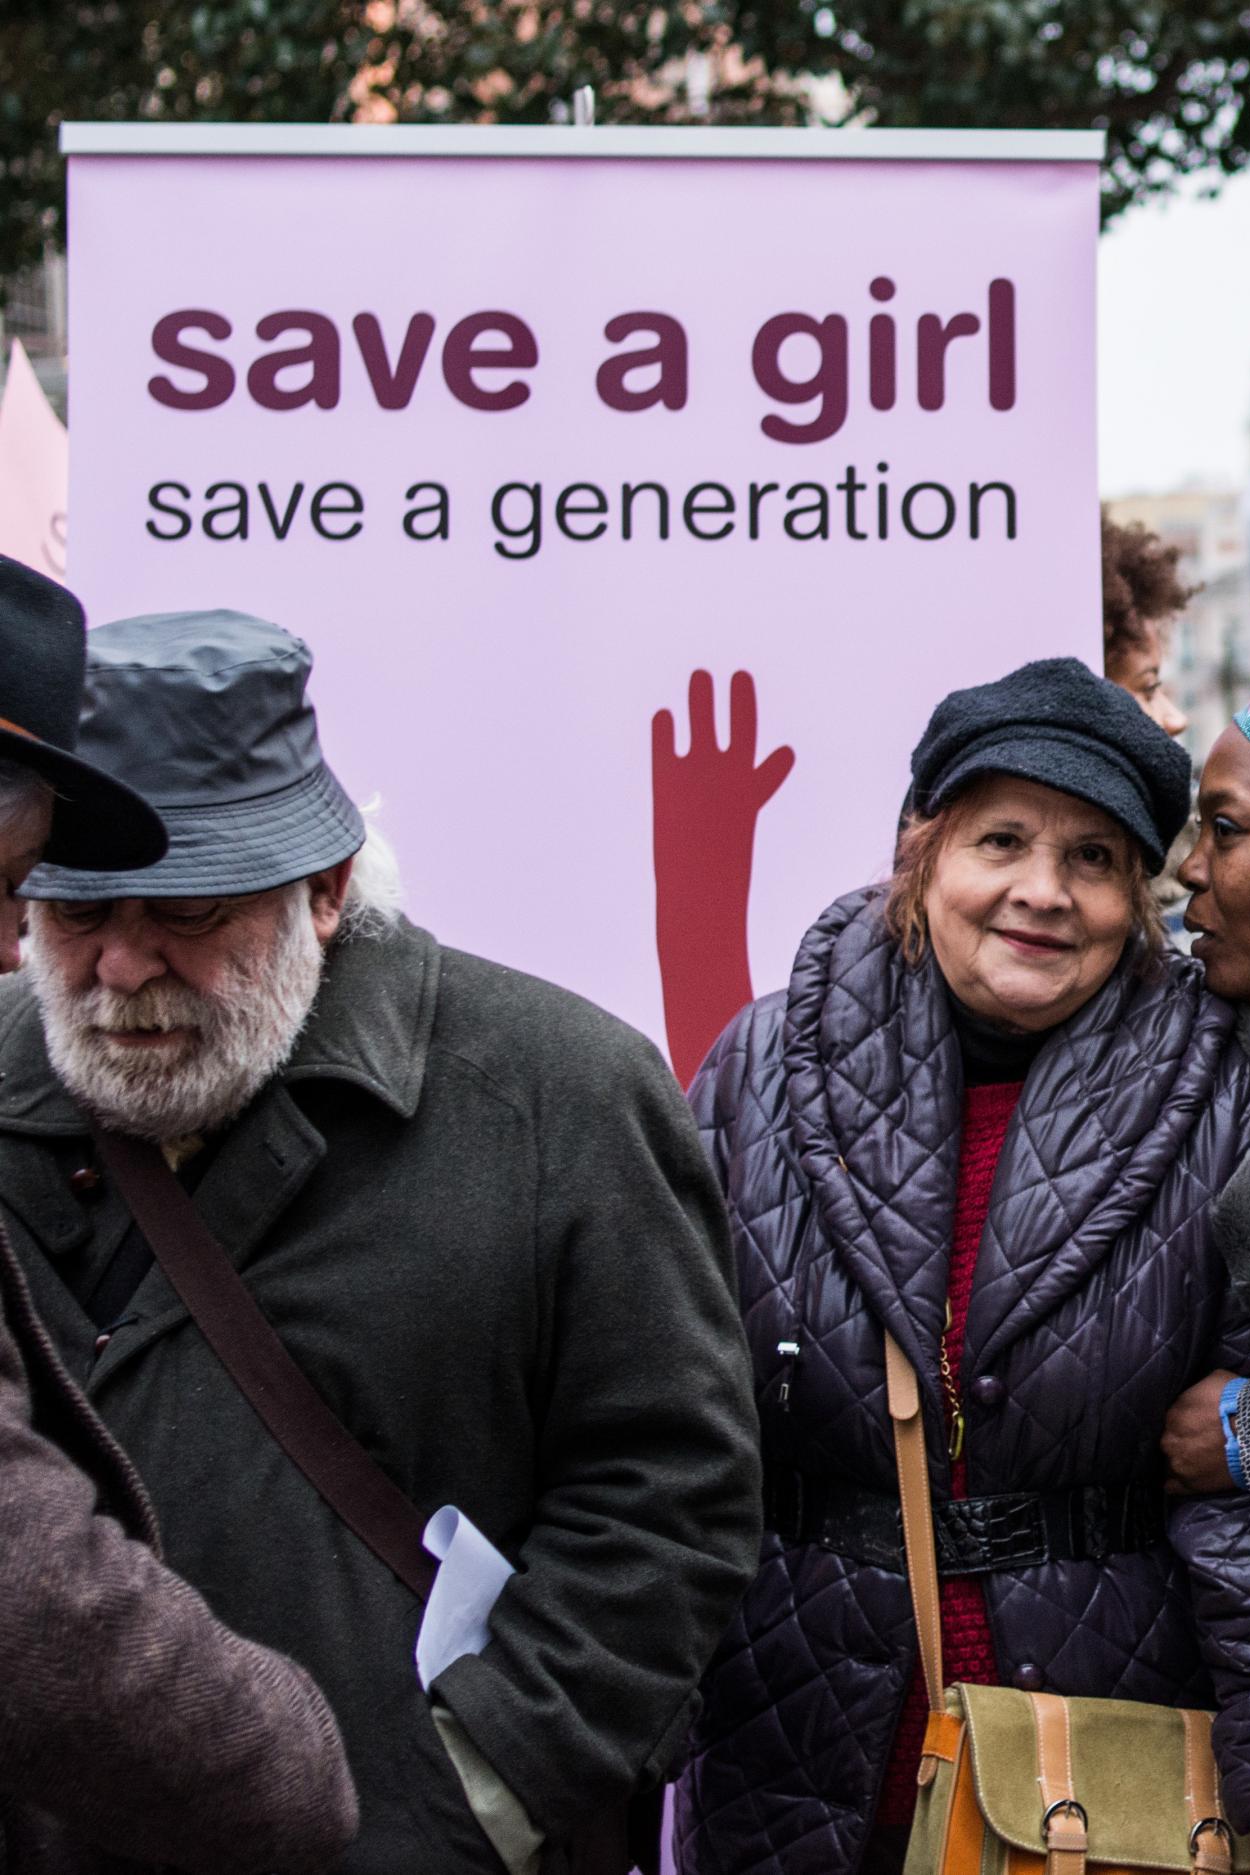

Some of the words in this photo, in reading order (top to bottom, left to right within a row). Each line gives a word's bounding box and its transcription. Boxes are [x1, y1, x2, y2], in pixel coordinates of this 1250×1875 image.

[148, 309, 539, 412] save
[596, 311, 688, 412] a
[752, 276, 1016, 445] girl
[146, 481, 364, 541] save
[403, 482, 449, 541] a
[491, 462, 1016, 560] generation
